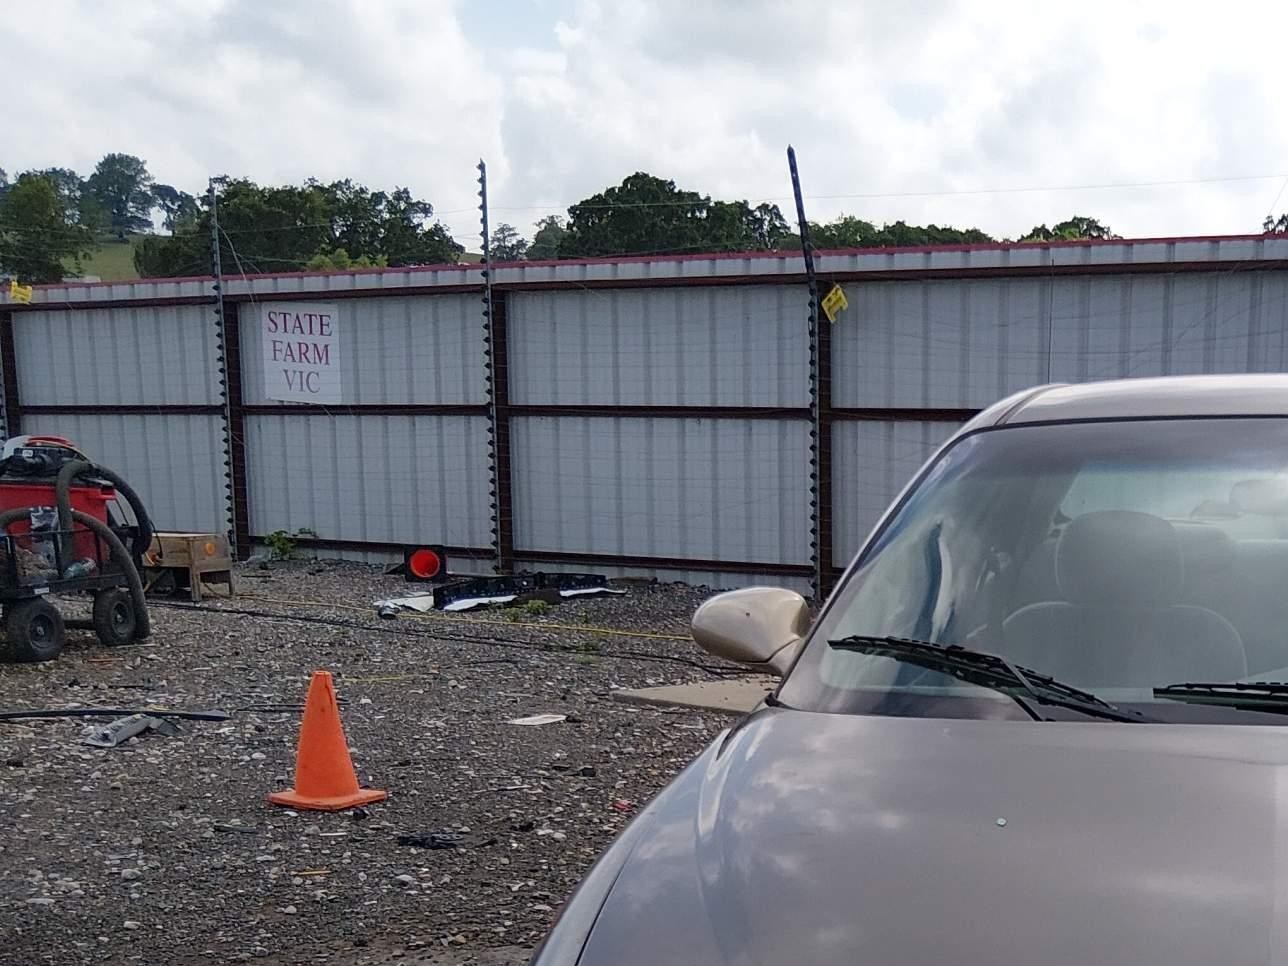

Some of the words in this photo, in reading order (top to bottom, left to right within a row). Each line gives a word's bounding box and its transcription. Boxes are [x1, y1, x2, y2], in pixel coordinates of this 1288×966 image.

[267, 311, 333, 337] STATE
[271, 339, 330, 366] FARM
[283, 368, 321, 394] VIC
